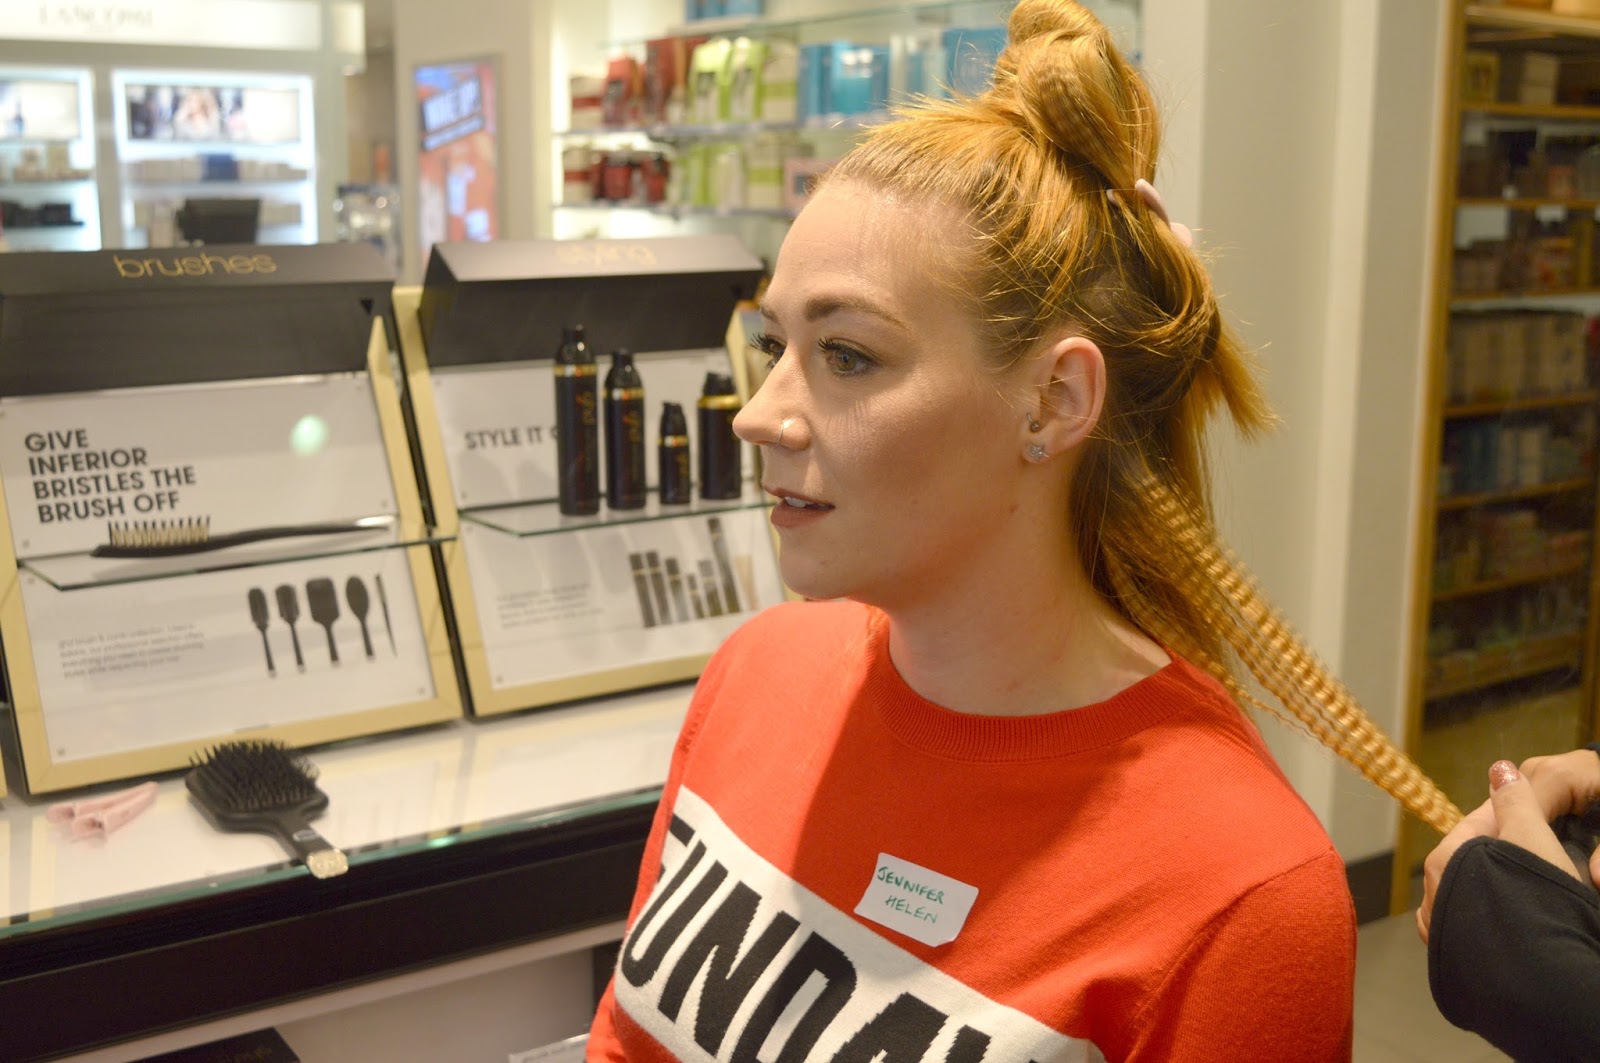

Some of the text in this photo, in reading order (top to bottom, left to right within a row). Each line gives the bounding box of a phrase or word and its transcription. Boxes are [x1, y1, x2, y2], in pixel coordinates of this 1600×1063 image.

[113, 251, 277, 278] brushes
[25, 429, 88, 452] GIVE
[464, 427, 521, 450] STYLE
[527, 425, 543, 445] IT
[28, 447, 148, 476] INFERIOR
[32, 465, 197, 500] BRISTLES THE
[37, 491, 180, 523] BRUSH OFF
[877, 866, 945, 905] JENNIFER
[885, 895, 938, 924] HELEN
